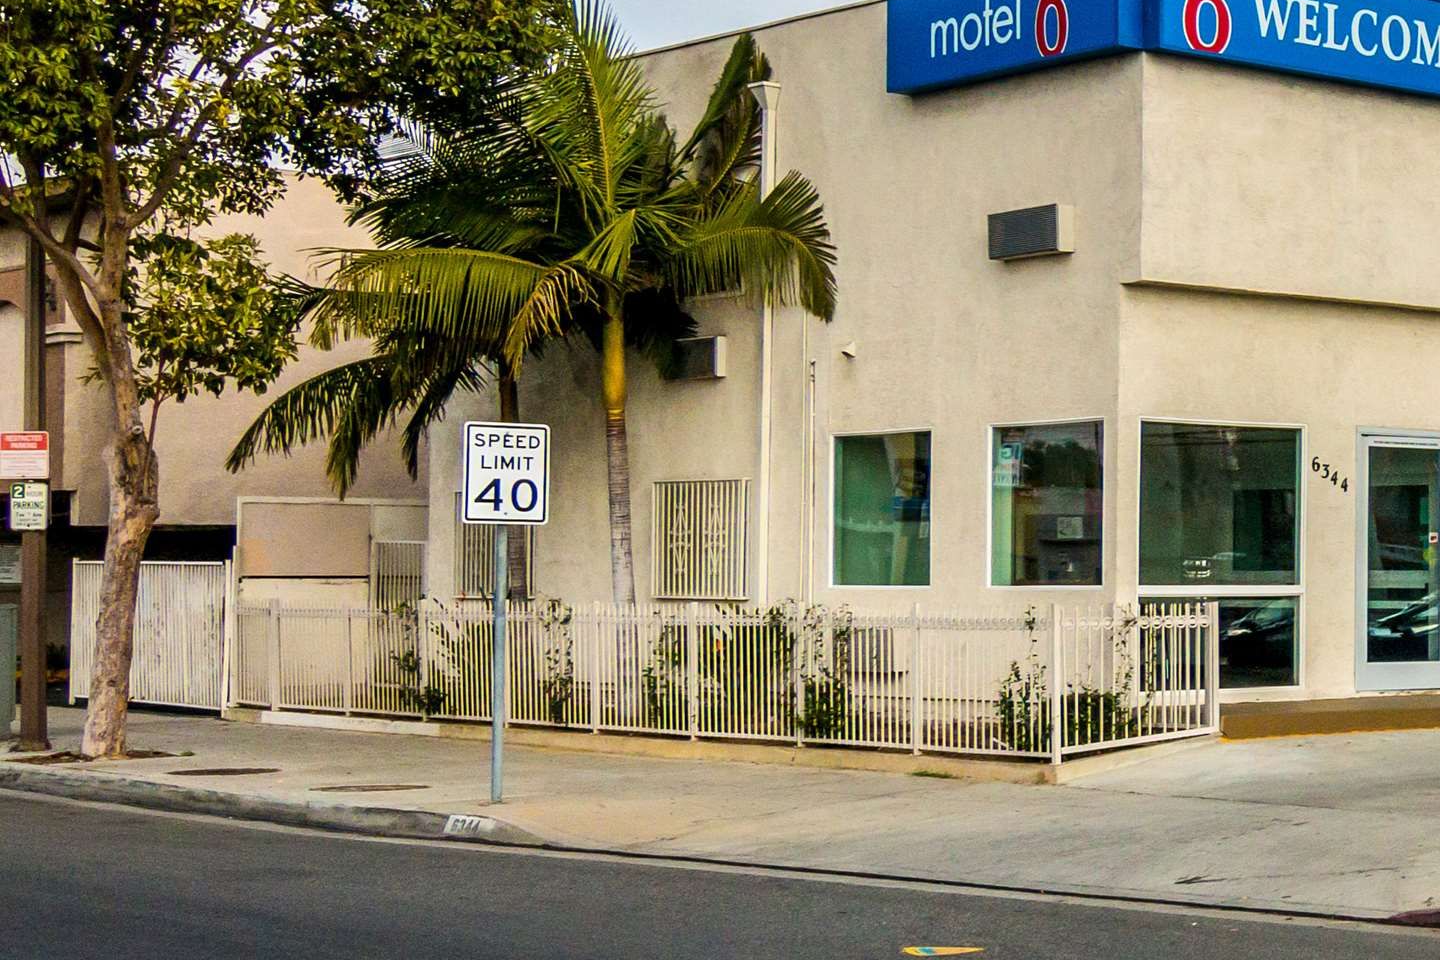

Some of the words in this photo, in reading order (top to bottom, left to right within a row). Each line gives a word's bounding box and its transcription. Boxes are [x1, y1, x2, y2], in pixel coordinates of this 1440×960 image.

[474, 433, 541, 449] SPEED
[481, 455, 534, 470] LIMIT
[1311, 456, 1348, 493] 6344
[13, 485, 24, 498] 2
[474, 478, 538, 512] 40
[13, 501, 45, 510] PARKING
